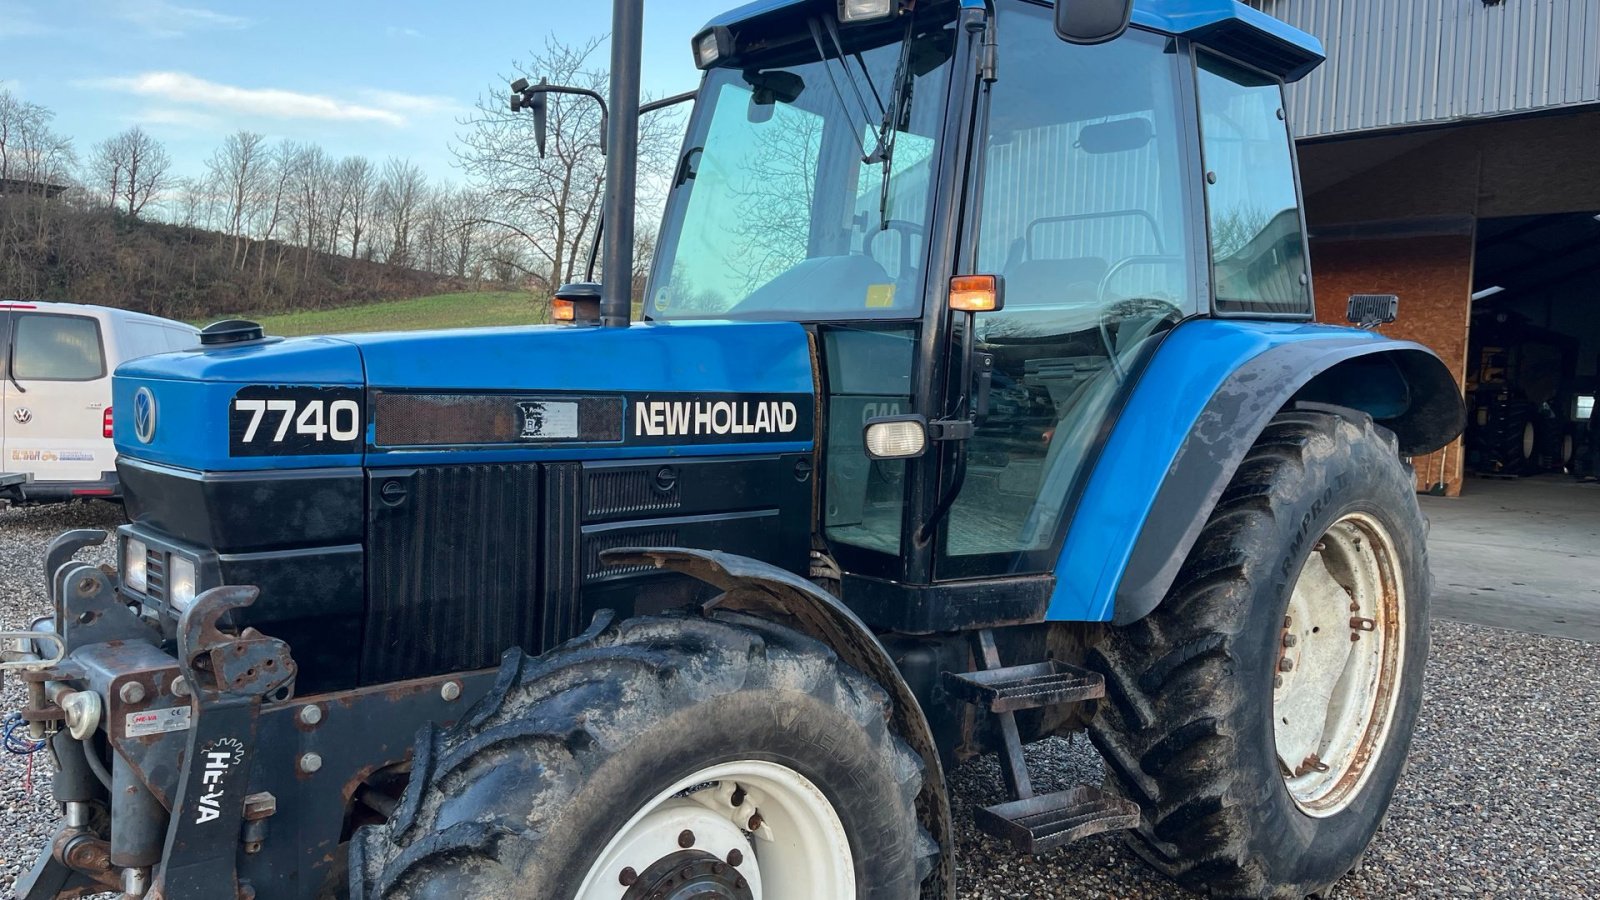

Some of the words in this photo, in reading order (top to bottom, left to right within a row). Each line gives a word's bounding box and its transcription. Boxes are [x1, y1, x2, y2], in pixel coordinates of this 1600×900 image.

[235, 399, 360, 442] 7740
[635, 401, 691, 436] NEW
[694, 401, 797, 435] HOLLAND
[195, 752, 231, 825] HE-VA
